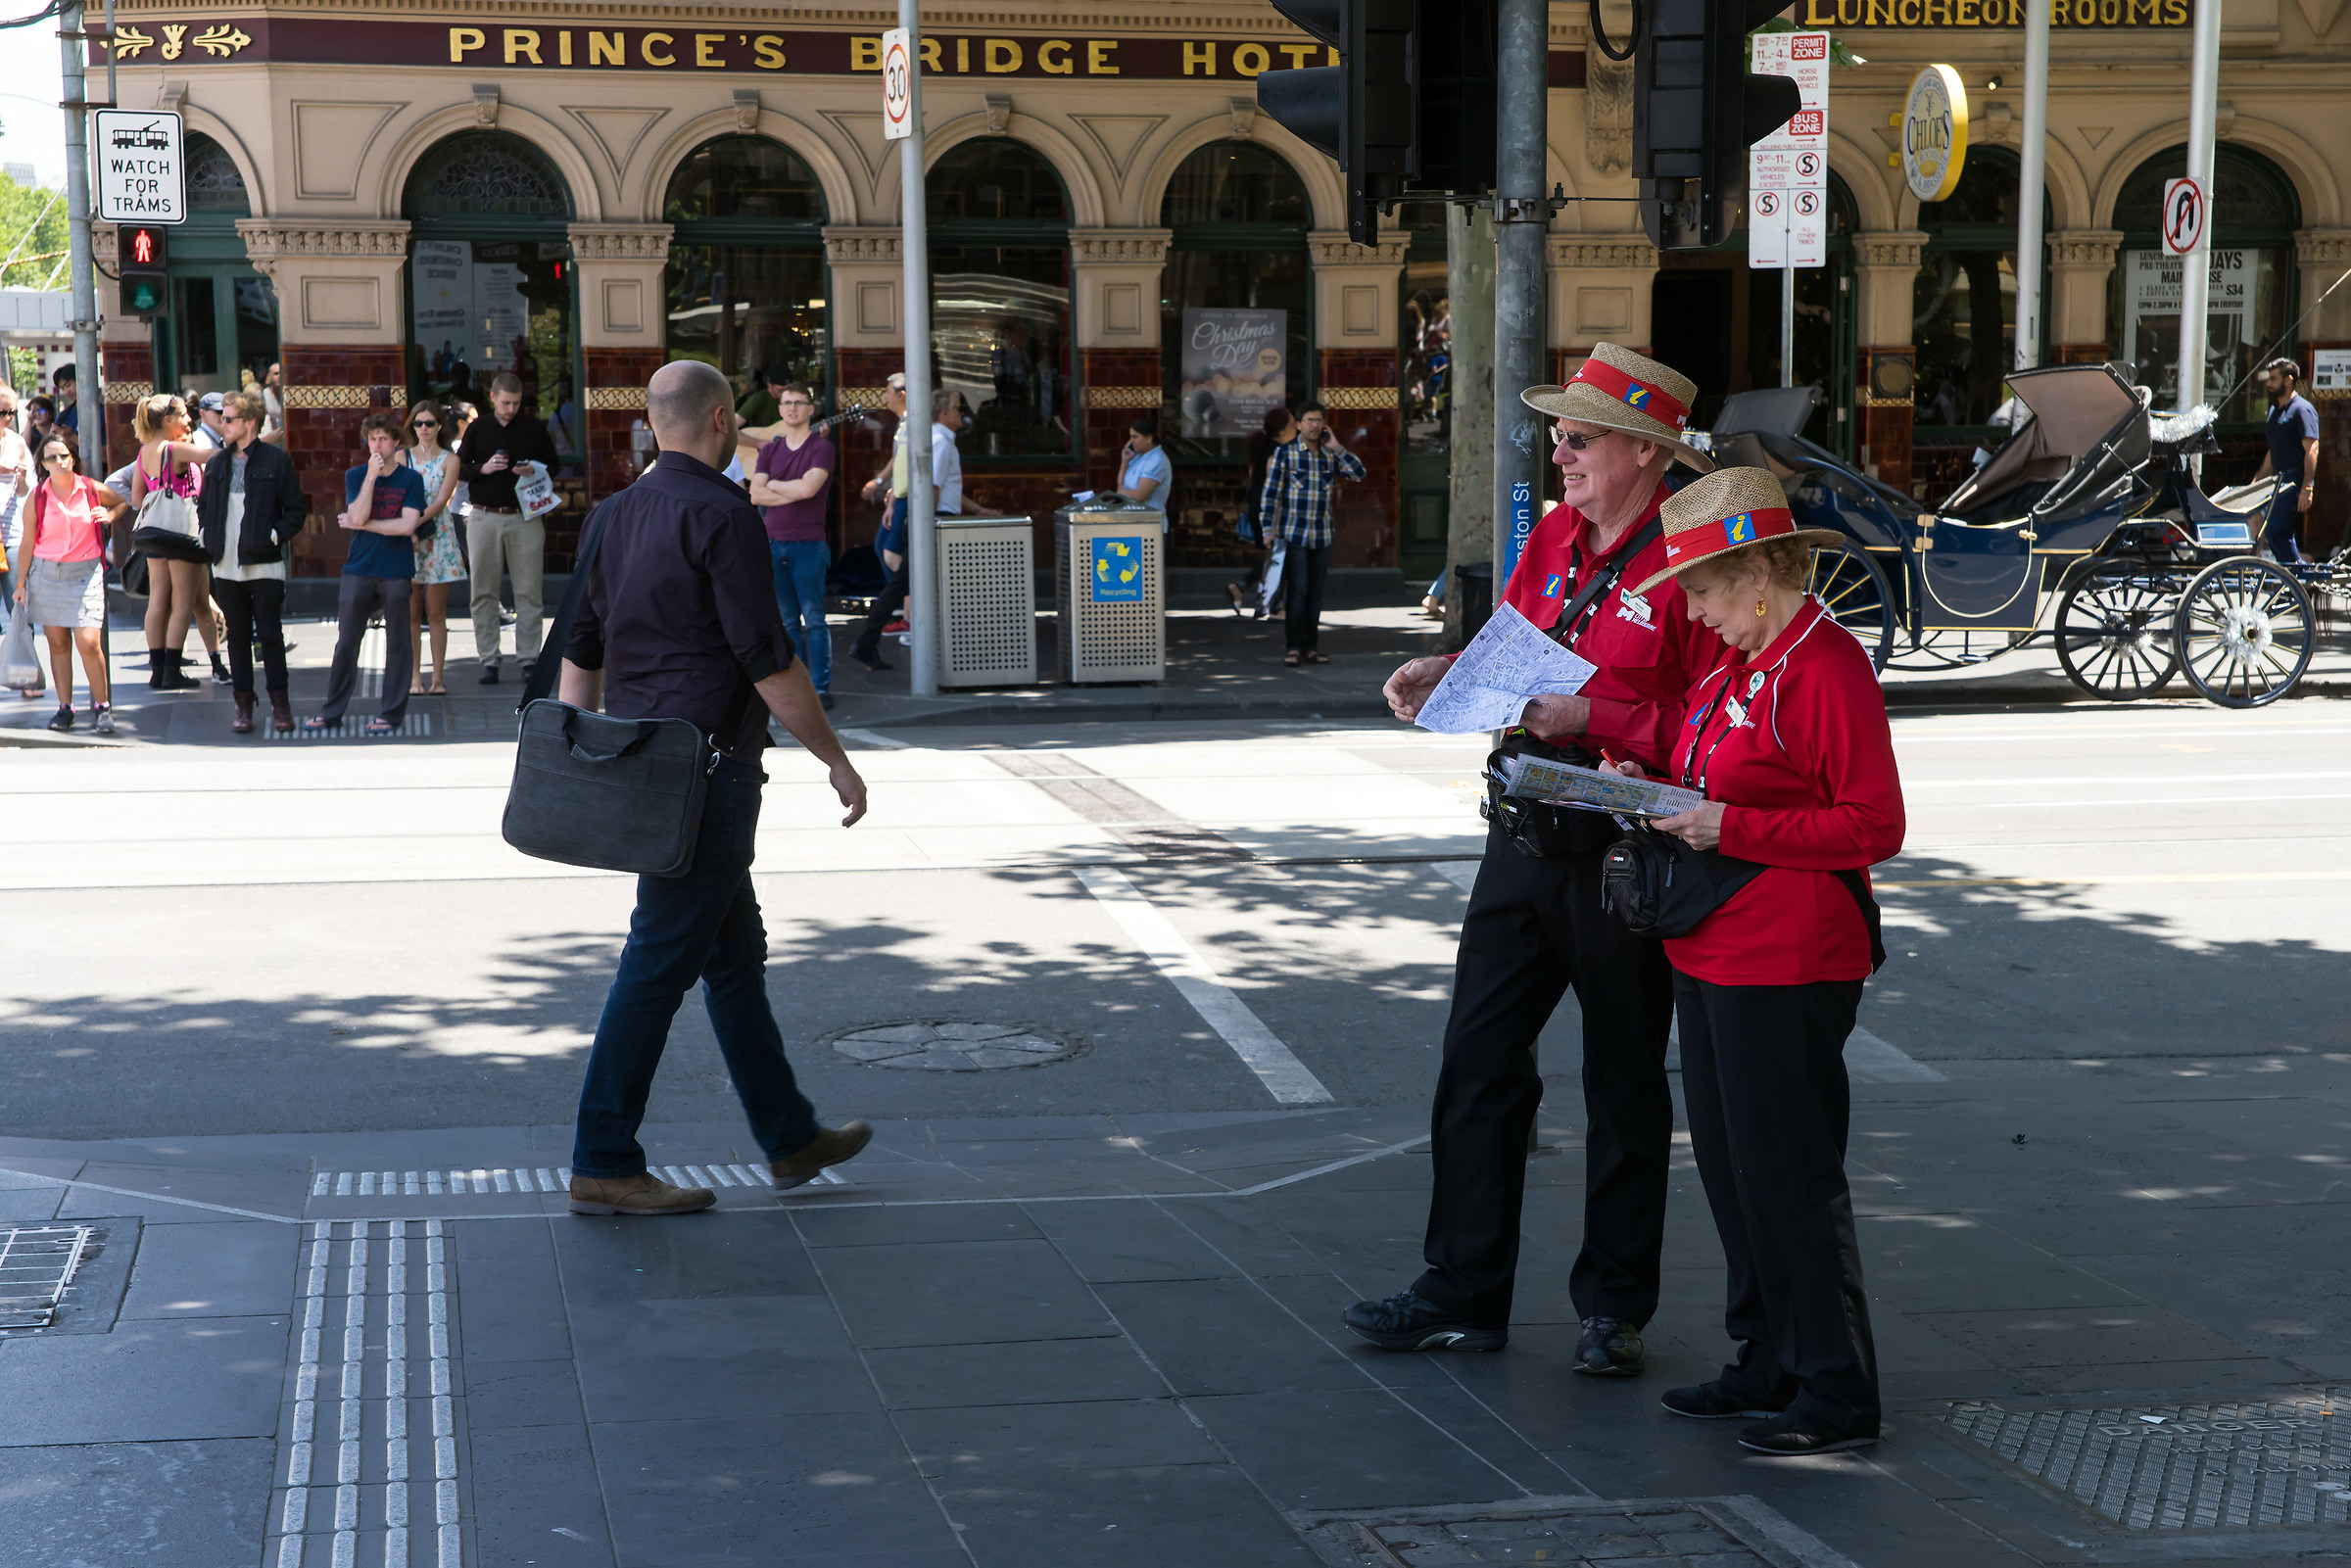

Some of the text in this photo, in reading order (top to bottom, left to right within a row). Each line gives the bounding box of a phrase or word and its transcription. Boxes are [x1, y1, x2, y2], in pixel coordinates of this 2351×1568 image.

[2049, 0, 2187, 25] ROOMS
[1793, 37, 1824, 48] PERMIT
[450, 27, 1340, 76] PRINCE'S BRIDGE HOT
[1794, 48, 1823, 58] ZONE
[888, 65, 906, 102] 30
[1794, 114, 1819, 123] BUS
[1792, 123, 1821, 133] ZONE
[111, 159, 170, 174] WATCH
[125, 178, 159, 193] FOR
[113, 197, 171, 213] TRAMS
[2139, 261, 2183, 270] PRE-THEATR
[1191, 320, 1277, 351] Christmas
[1210, 340, 1260, 369] Day
[1512, 481, 1530, 502] St
[2098, 1419, 2320, 1437] DANGER
